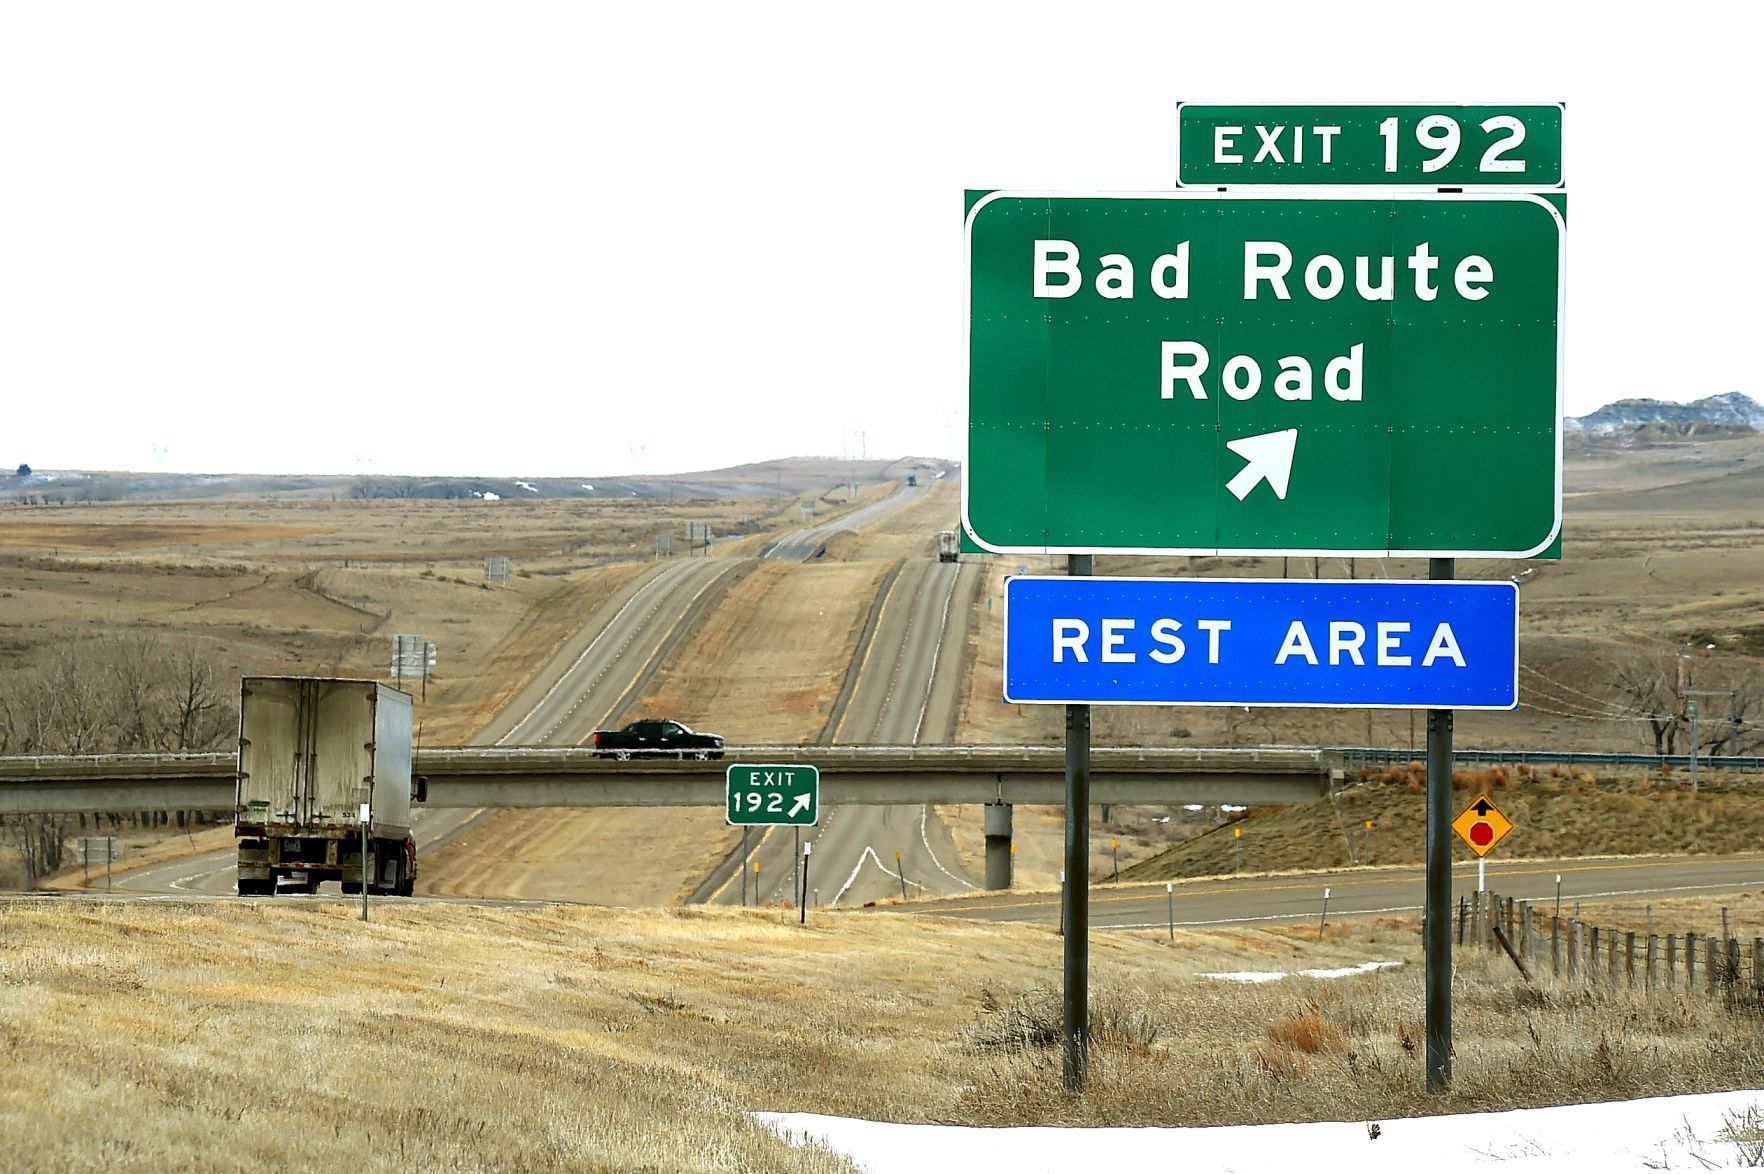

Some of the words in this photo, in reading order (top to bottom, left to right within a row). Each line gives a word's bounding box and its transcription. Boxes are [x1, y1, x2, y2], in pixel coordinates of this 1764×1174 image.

[1214, 125, 1341, 165] EXIT
[1379, 114, 1526, 173] 192
[1033, 239, 1190, 300] Bad
[1243, 241, 1494, 302] Route
[1160, 340, 1364, 402] Road
[1052, 618, 1232, 664] REST
[1274, 620, 1467, 667] AREA
[733, 791, 783, 813] 192
[750, 772, 795, 786] EXIT
